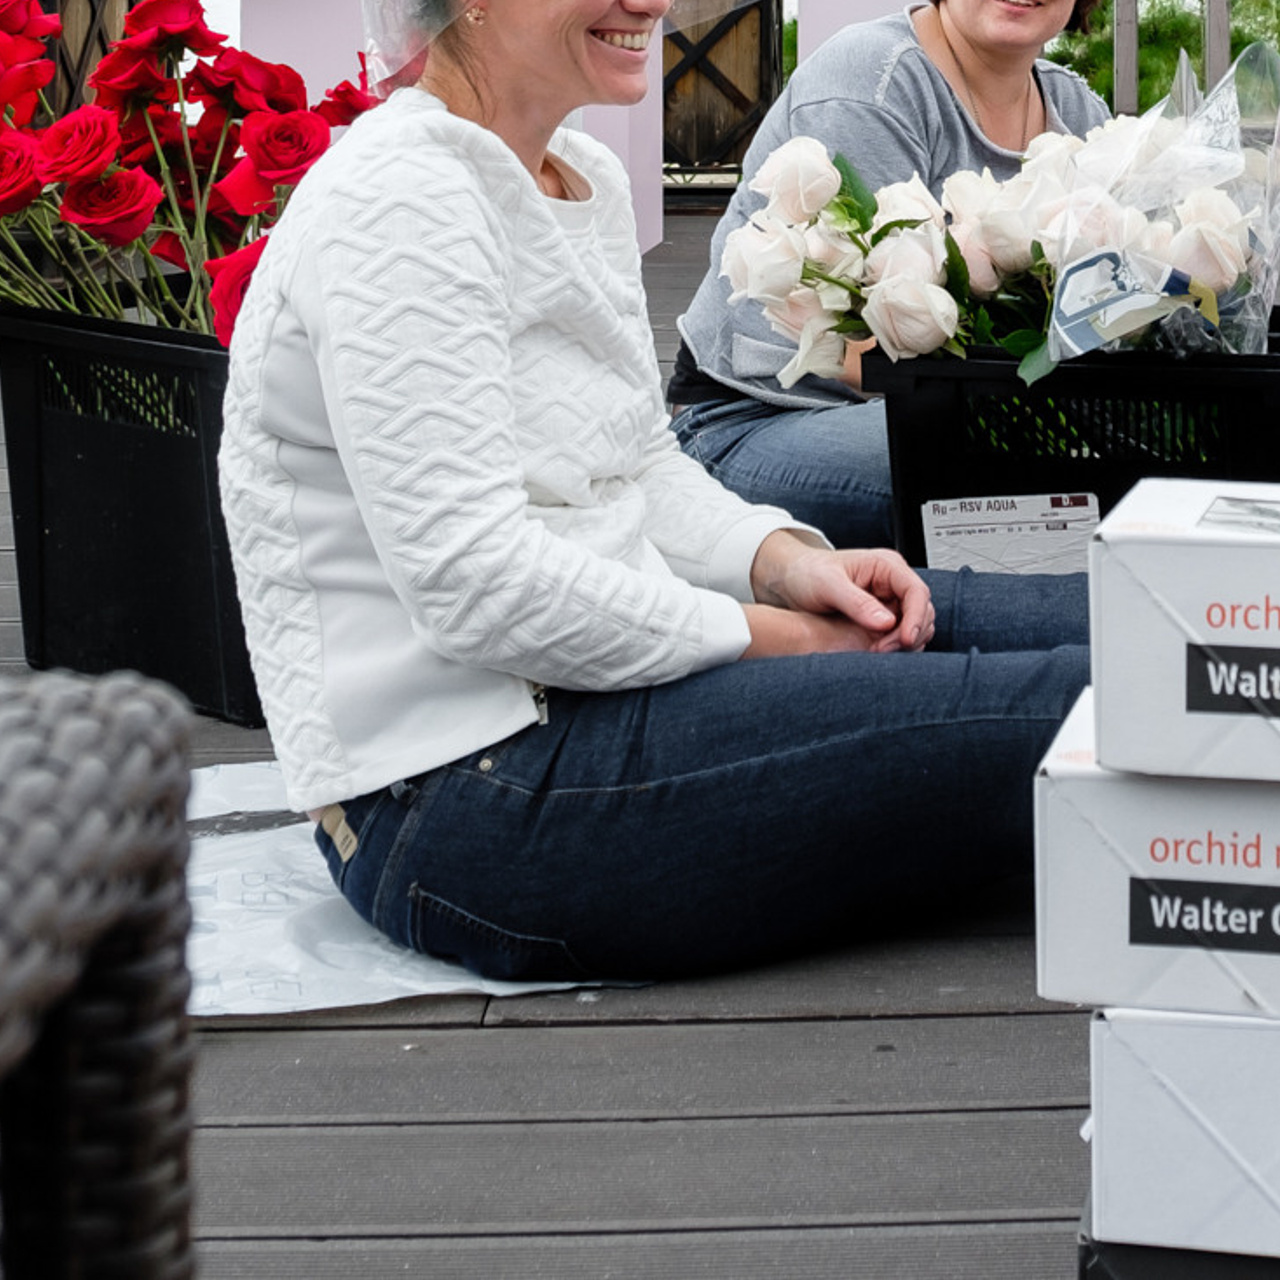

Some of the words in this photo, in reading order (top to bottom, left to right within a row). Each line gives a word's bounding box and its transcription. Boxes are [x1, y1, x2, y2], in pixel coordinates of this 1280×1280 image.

[960, 500, 983, 513] RSV
[1149, 830, 1262, 869] orchid
[1150, 895, 1264, 934] Walter
